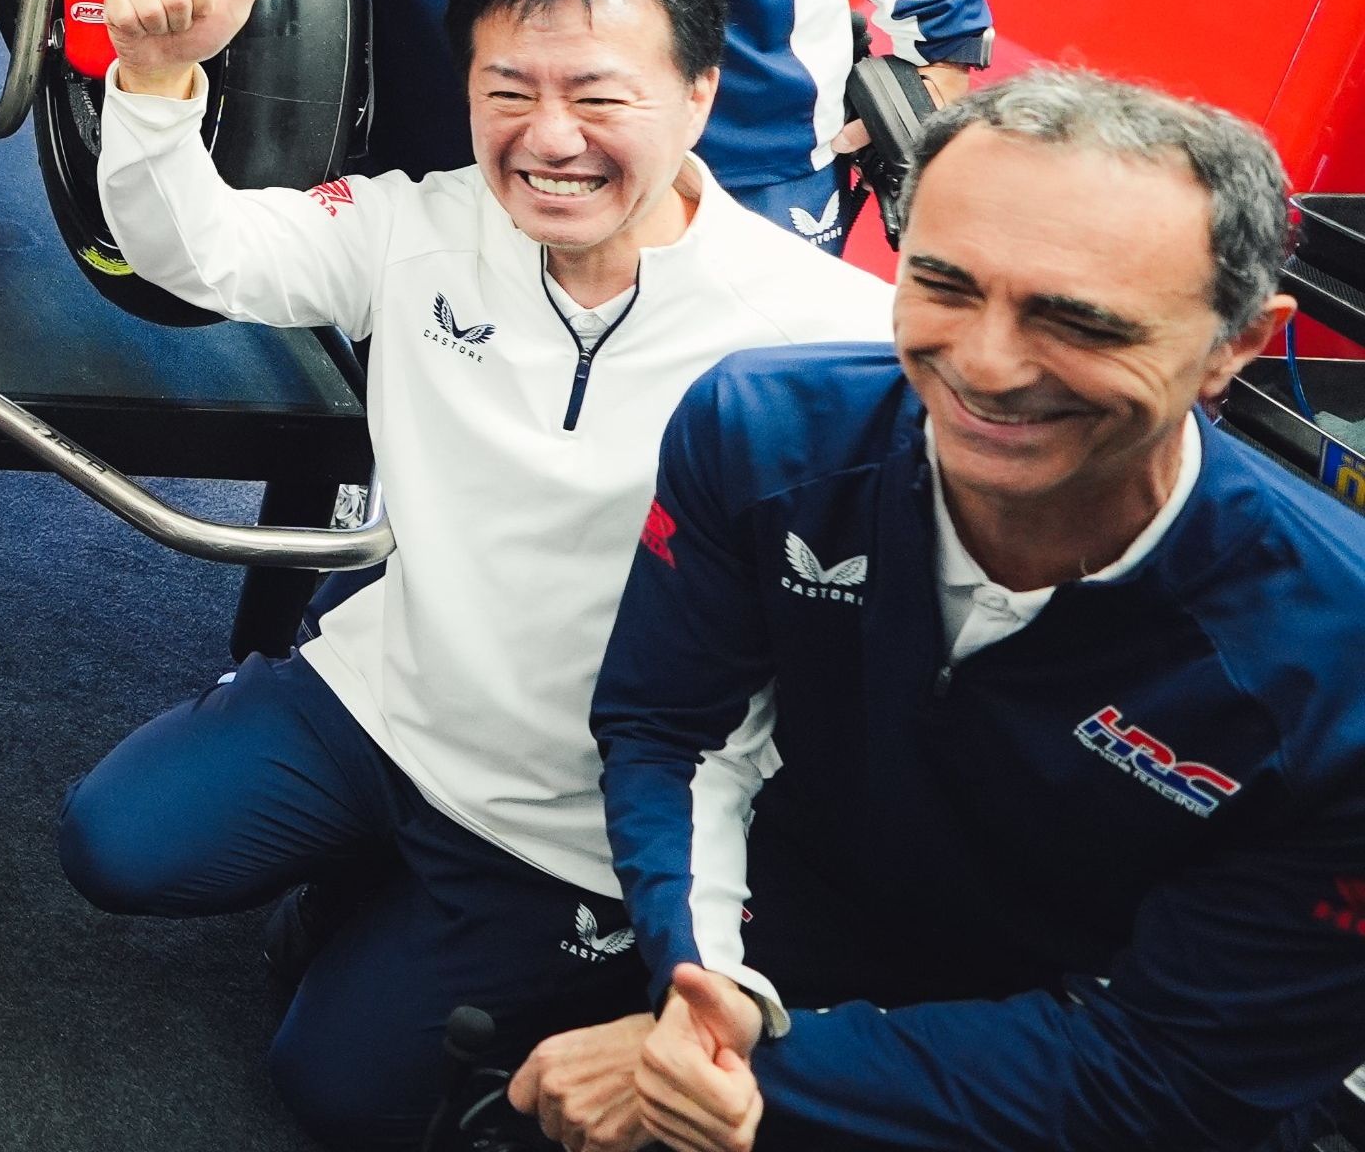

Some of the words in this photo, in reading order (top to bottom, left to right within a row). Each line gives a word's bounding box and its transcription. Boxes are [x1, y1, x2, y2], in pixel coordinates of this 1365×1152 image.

[423, 328, 485, 364] CASTORE
[1076, 704, 1242, 814] HRC
[1132, 769, 1211, 819] RACING
[559, 939, 607, 964] CAST
